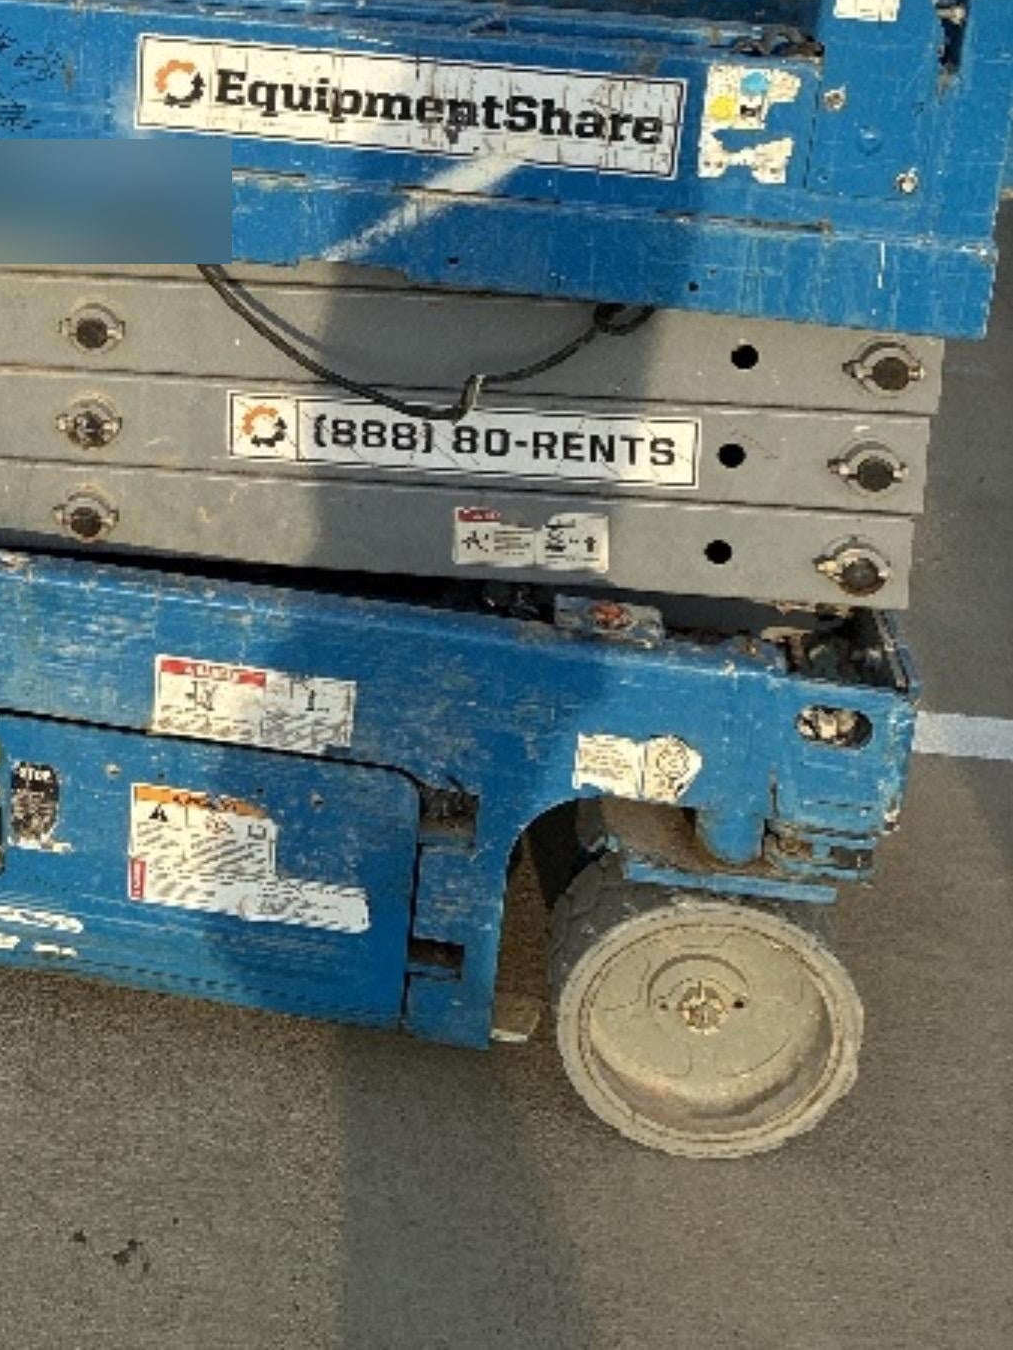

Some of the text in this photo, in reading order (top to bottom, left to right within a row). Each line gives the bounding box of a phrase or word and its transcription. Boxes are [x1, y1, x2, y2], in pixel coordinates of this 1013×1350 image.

[215, 69, 663, 145] EquipmentShare
[313, 414, 676, 467] (888) 80-RENTS
